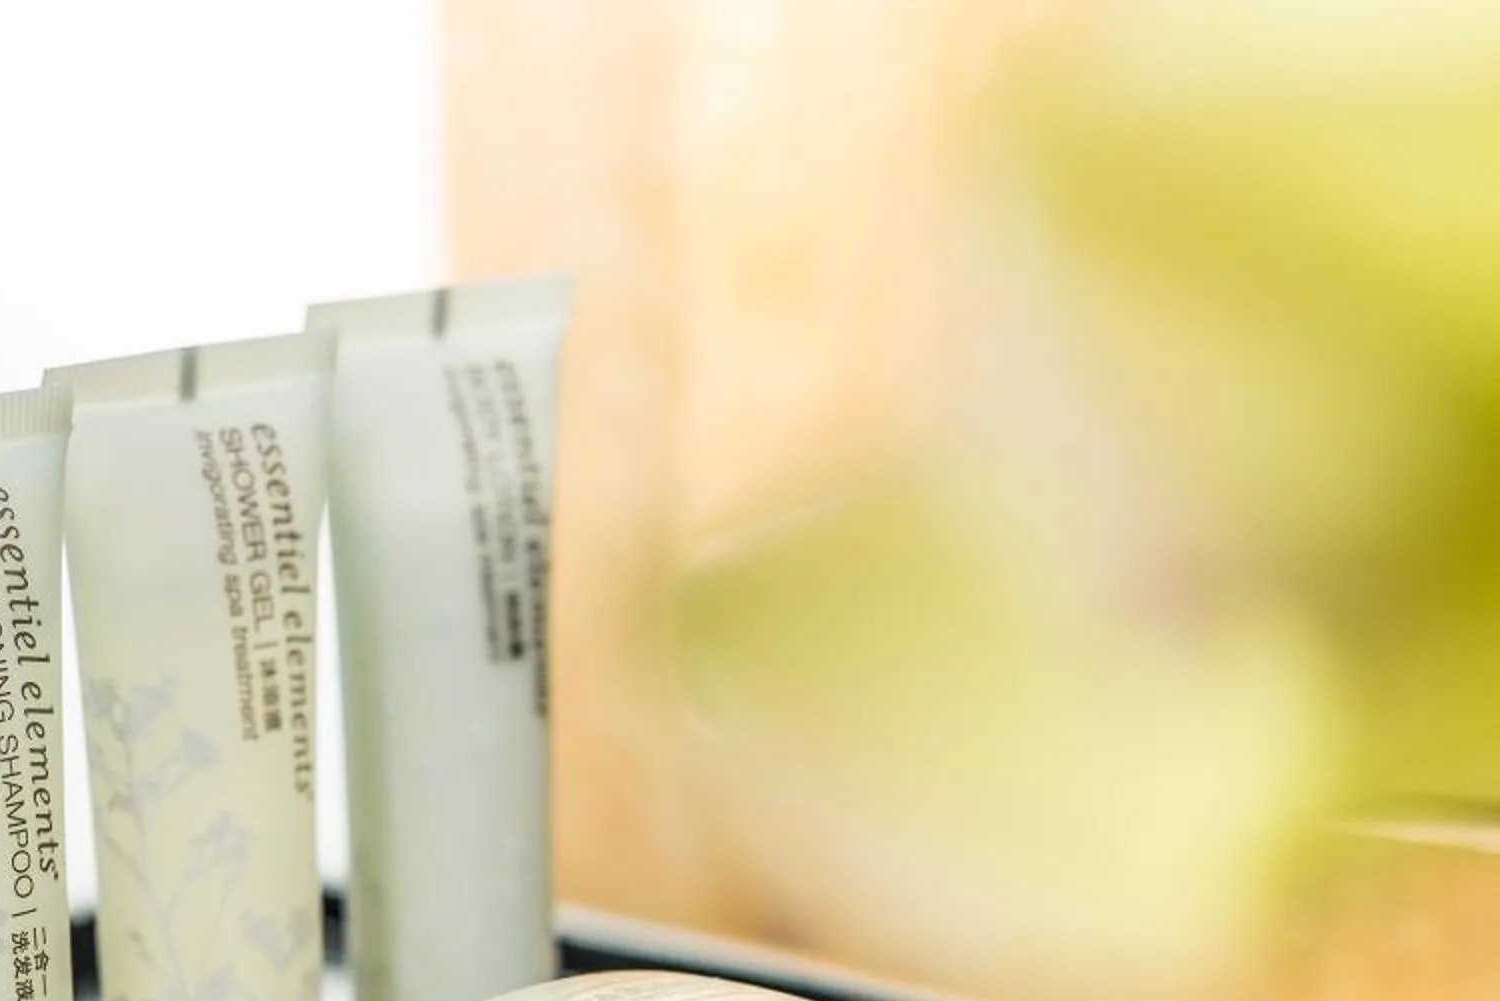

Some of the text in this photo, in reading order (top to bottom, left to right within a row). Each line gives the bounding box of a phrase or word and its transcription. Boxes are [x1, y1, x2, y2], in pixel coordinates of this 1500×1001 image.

[196, 429, 239, 565] invigorating
[222, 573, 243, 618] spa
[219, 426, 275, 632] SHOWER GEL
[250, 422, 310, 596] essentiel
[33, 926, 50, 998] 二合一
